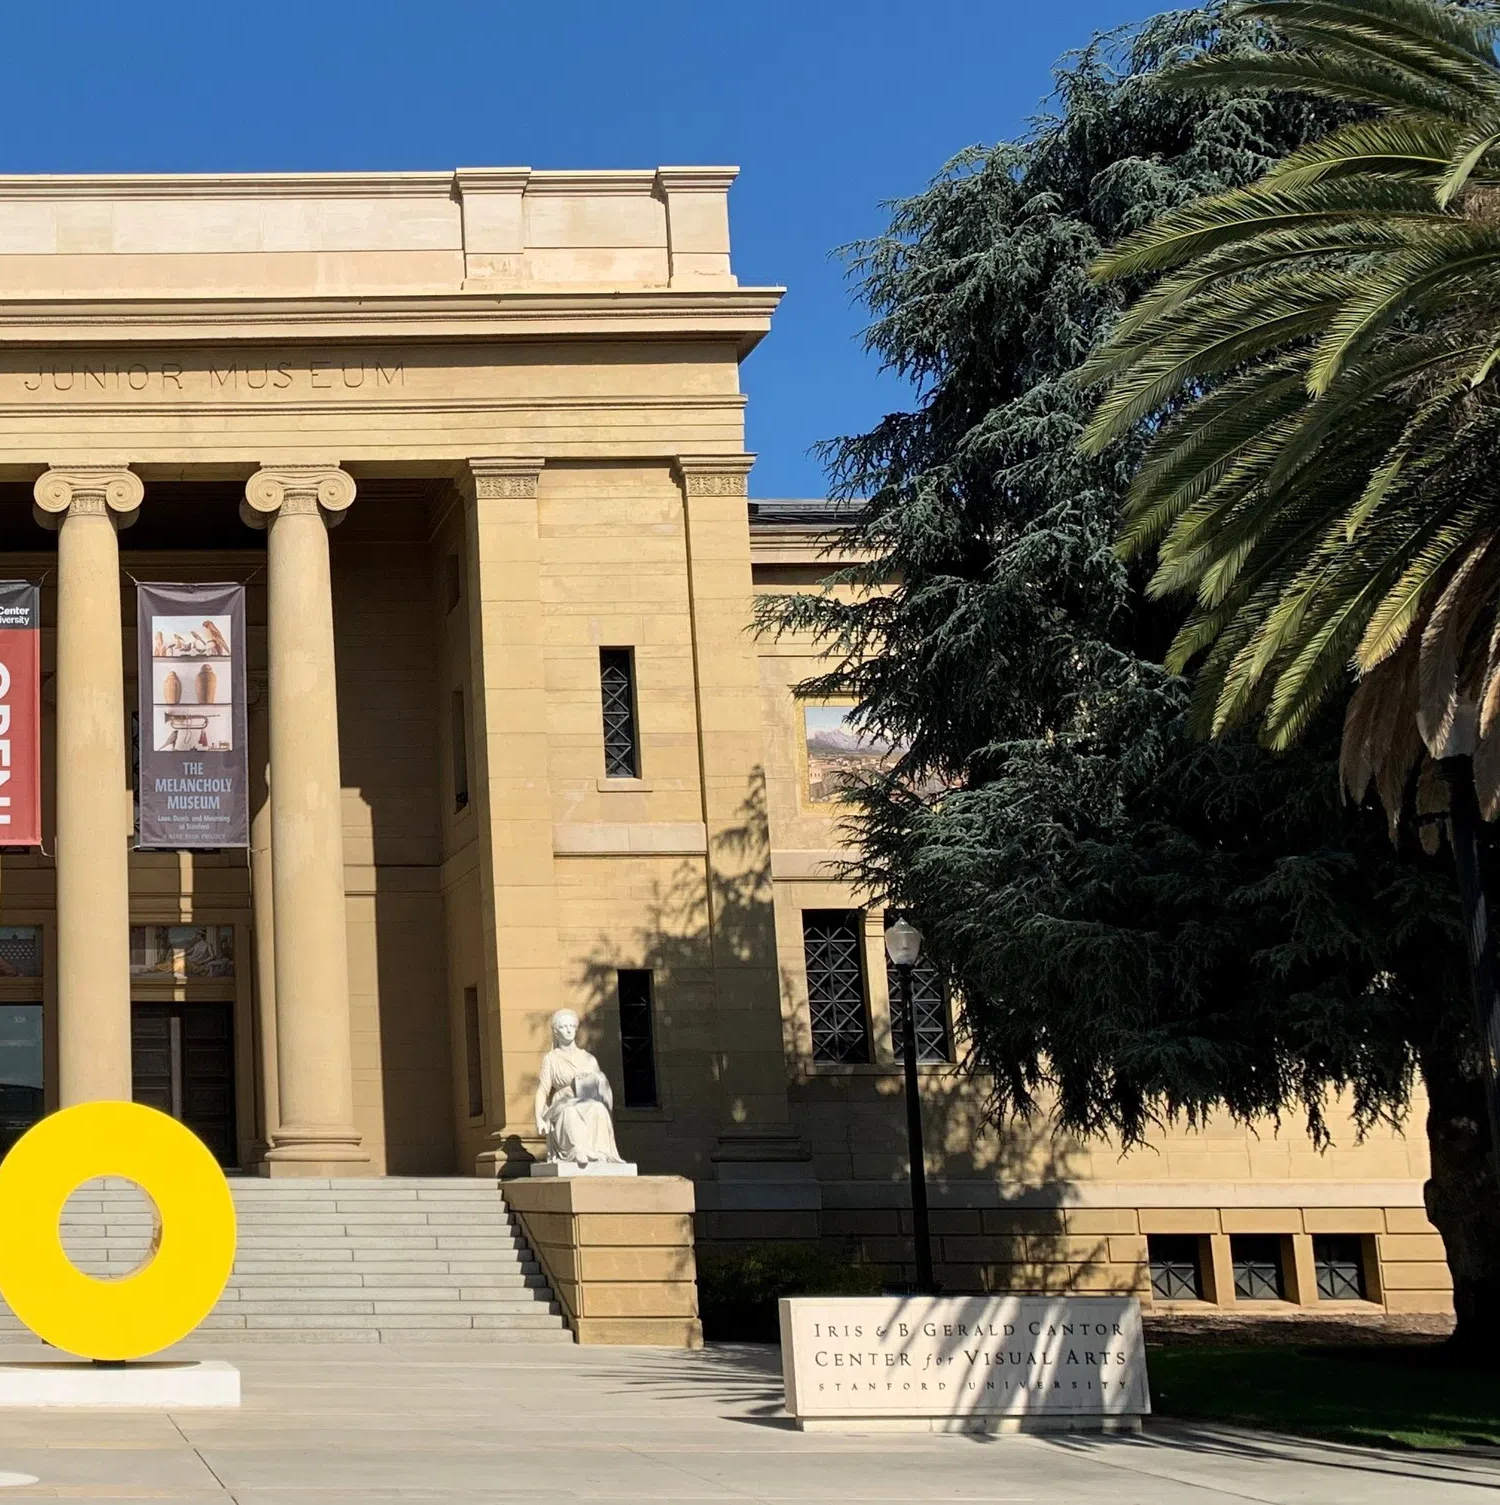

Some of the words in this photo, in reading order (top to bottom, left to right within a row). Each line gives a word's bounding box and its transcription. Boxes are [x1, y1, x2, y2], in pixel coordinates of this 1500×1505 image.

[23, 362, 184, 392] JUNIOR
[209, 360, 405, 390] MUSEUM
[182, 762, 204, 775] THE
[155, 779, 233, 792] MELANCHOLY
[167, 796, 221, 809] MUSEUM
[814, 1323, 863, 1337] IRIS
[875, 1325, 887, 1337] &
[898, 1322, 910, 1337] B
[923, 1322, 1015, 1337] GERALD
[1028, 1321, 1123, 1336] CANTOR
[814, 1351, 912, 1366] CENTER
[922, 1353, 954, 1371] for
[963, 1350, 1053, 1366] VISUAL
[1066, 1348, 1126, 1365] ARTS
[818, 1382, 946, 1391] STANFORD
[968, 1381, 1127, 1390] UNIVERSITY
